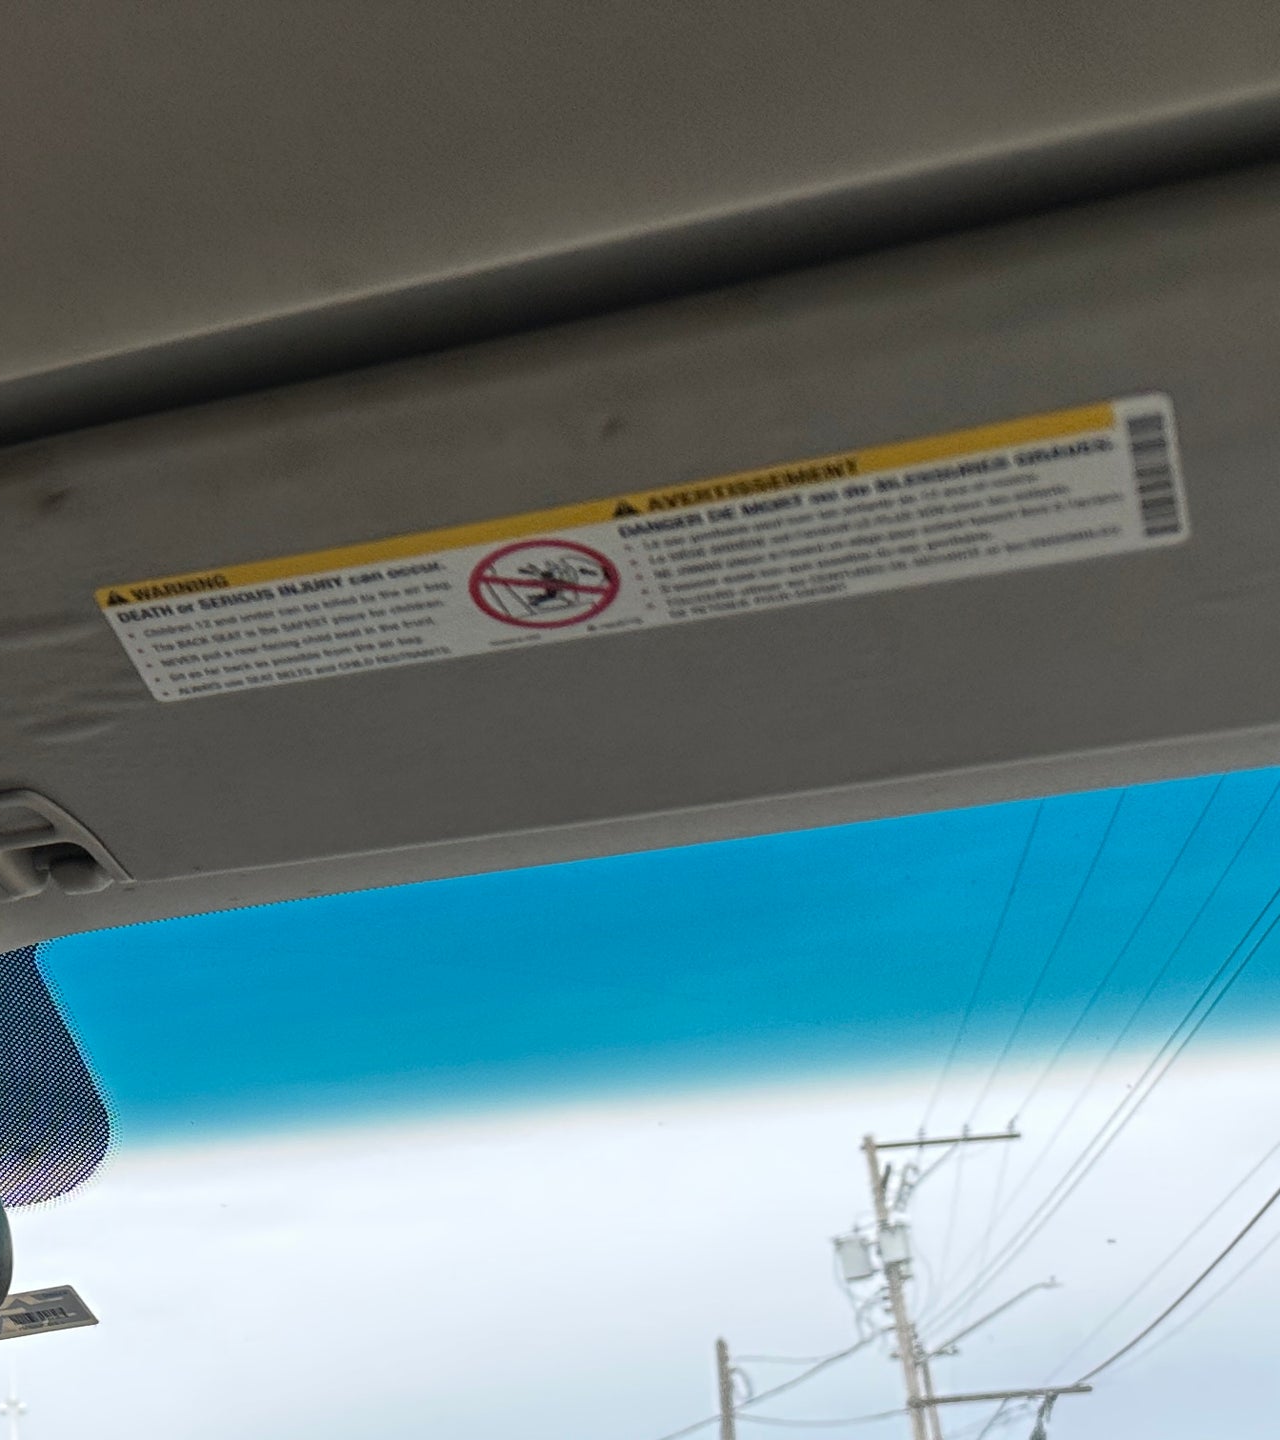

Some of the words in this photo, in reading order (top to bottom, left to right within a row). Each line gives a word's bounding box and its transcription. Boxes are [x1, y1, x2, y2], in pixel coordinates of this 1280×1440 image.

[118, 605, 172, 624] DEATH
[176, 602, 194, 614] or
[198, 588, 274, 611] SERIOUS
[277, 576, 341, 597] INJURY
[348, 569, 382, 585] can
[386, 558, 444, 578] occur.
[132, 574, 228, 600] WARNING
